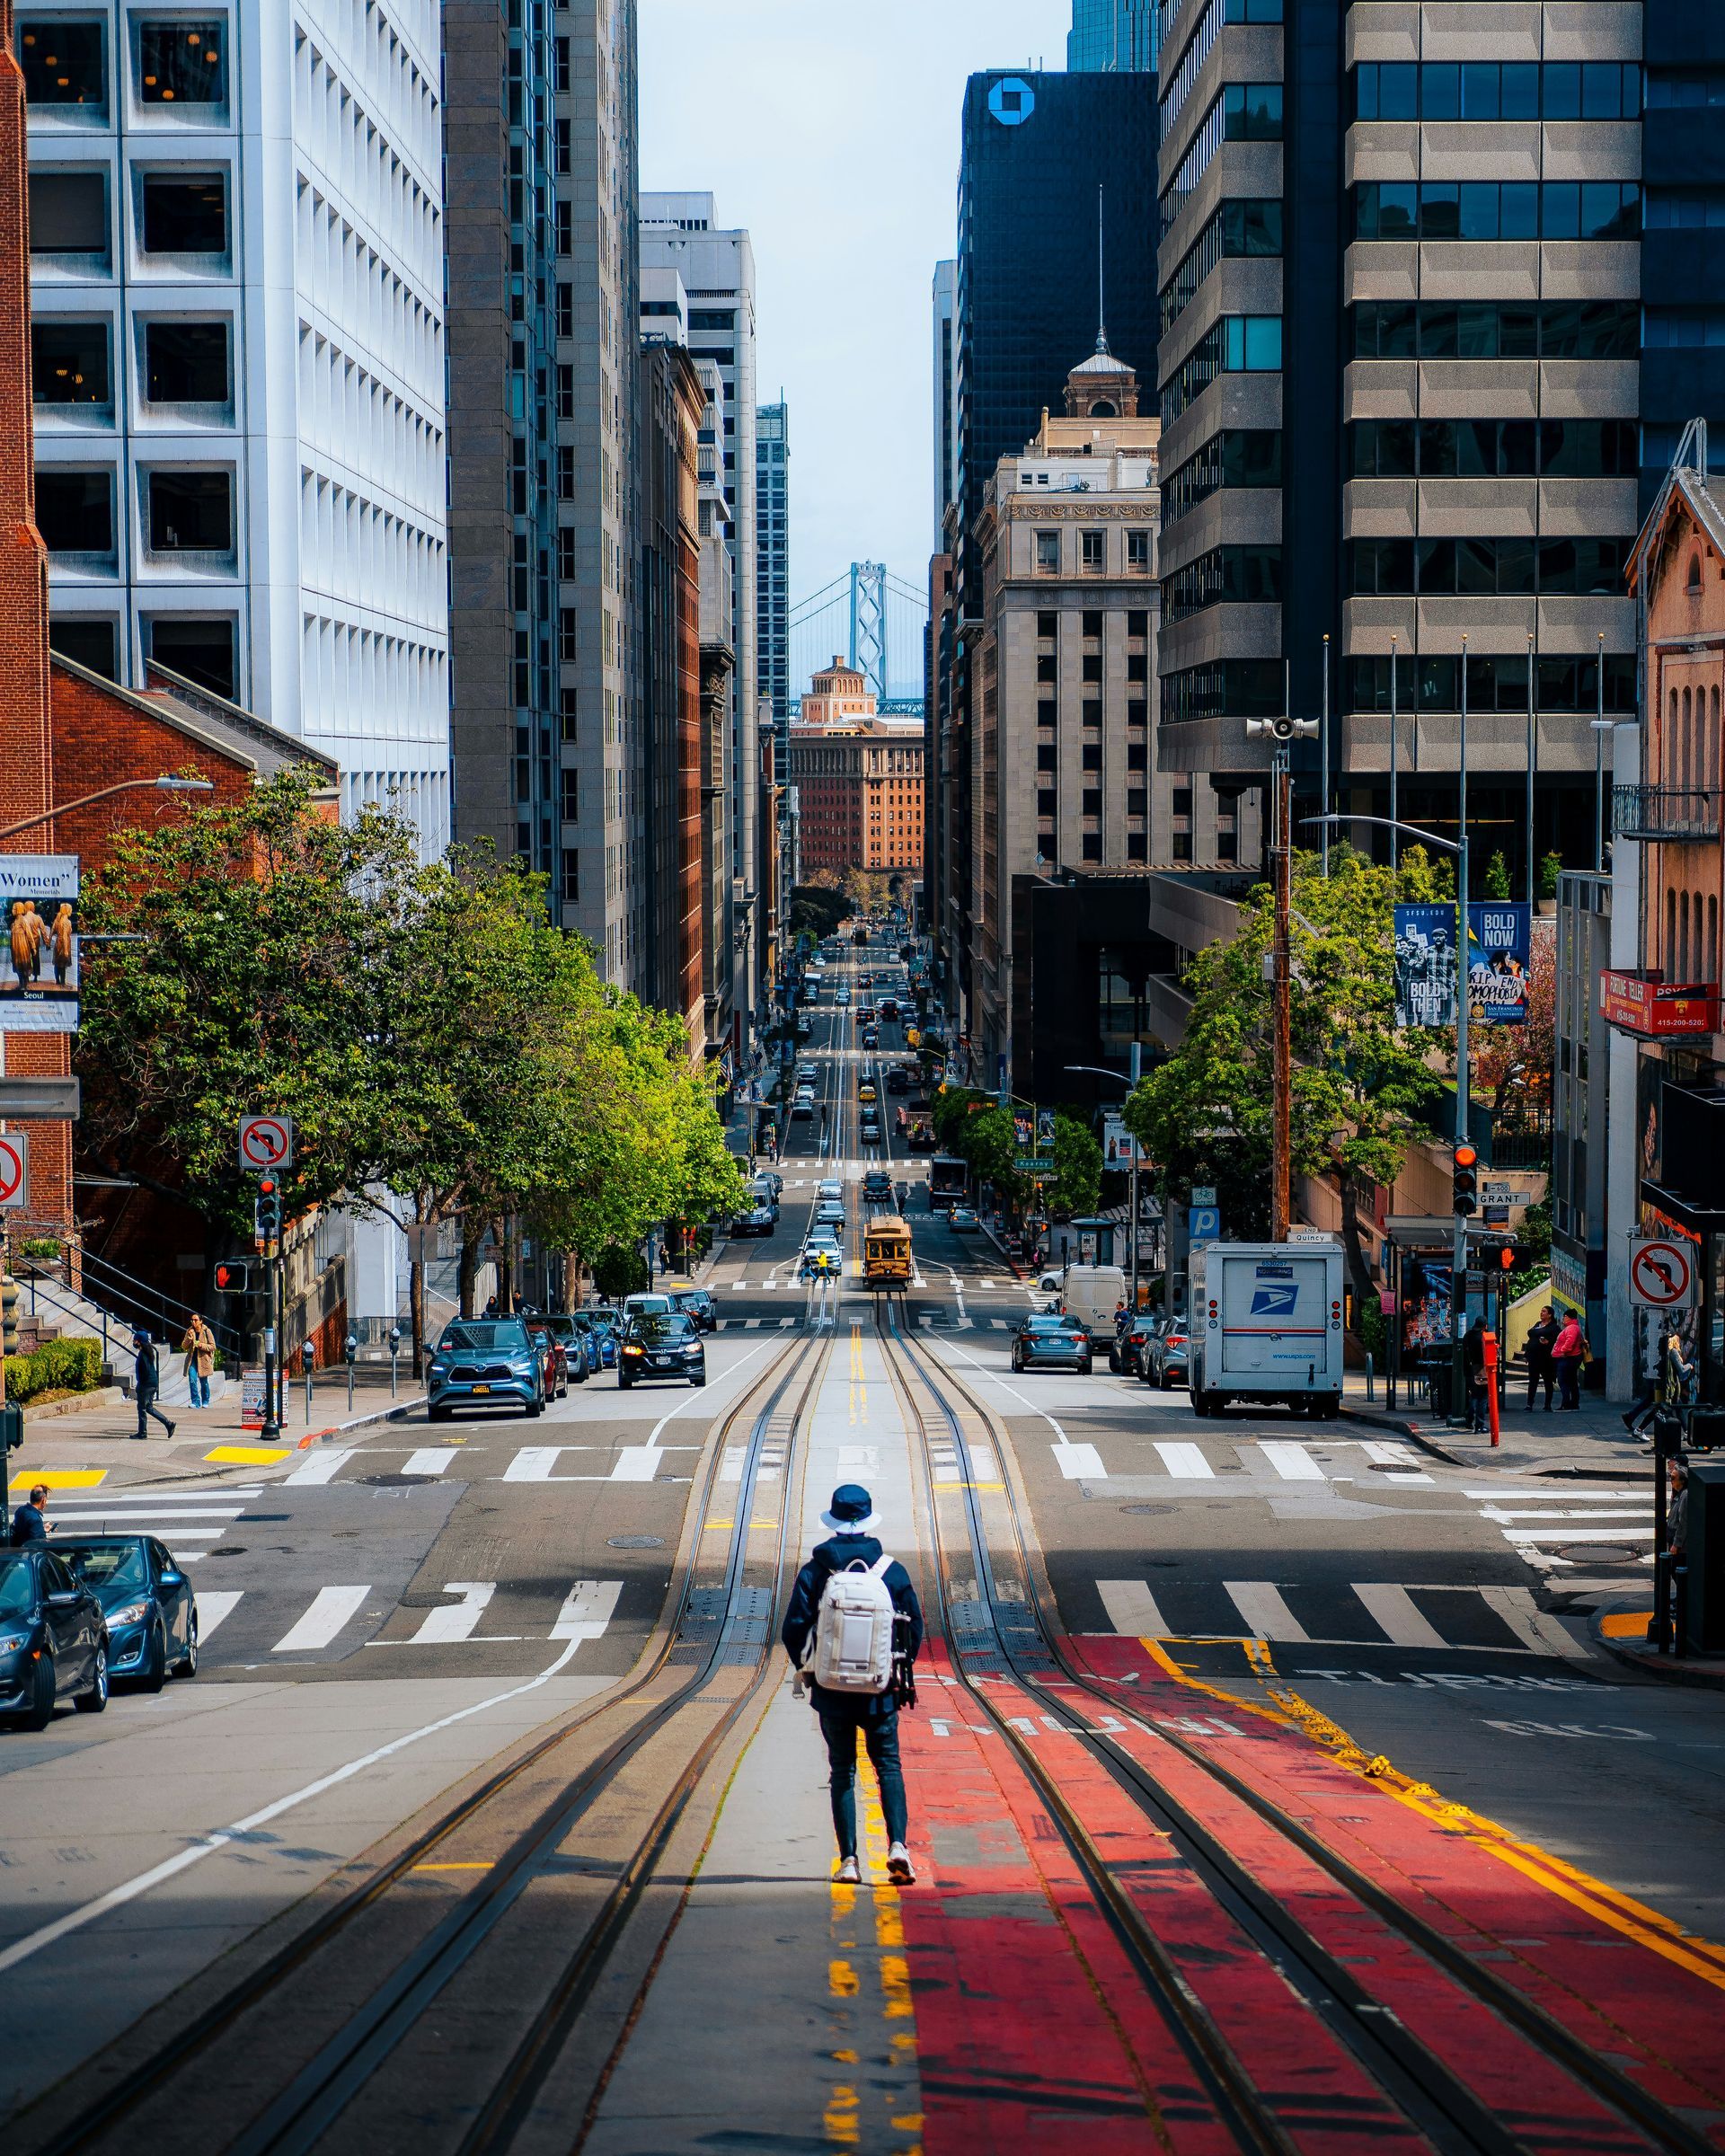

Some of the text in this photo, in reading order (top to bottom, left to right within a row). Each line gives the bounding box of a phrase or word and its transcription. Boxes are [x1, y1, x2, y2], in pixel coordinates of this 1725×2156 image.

[1484, 915, 1515, 930] BOLD
[1484, 930, 1515, 947] NOW
[1411, 982, 1441, 997] BOLD
[1501, 976, 1518, 989] END
[1610, 976, 1626, 997] FORTUNE
[1628, 981, 1644, 1002] TELLER
[24, 991, 44, 999] Seoul
[1467, 985, 1518, 1000] OMOPHOBIA
[1411, 998, 1441, 1012] THEN
[1480, 1195, 1520, 1203] GRANT
[1296, 1234, 1324, 1242] Quincy
[1295, 1669, 1621, 1691] TURNS
